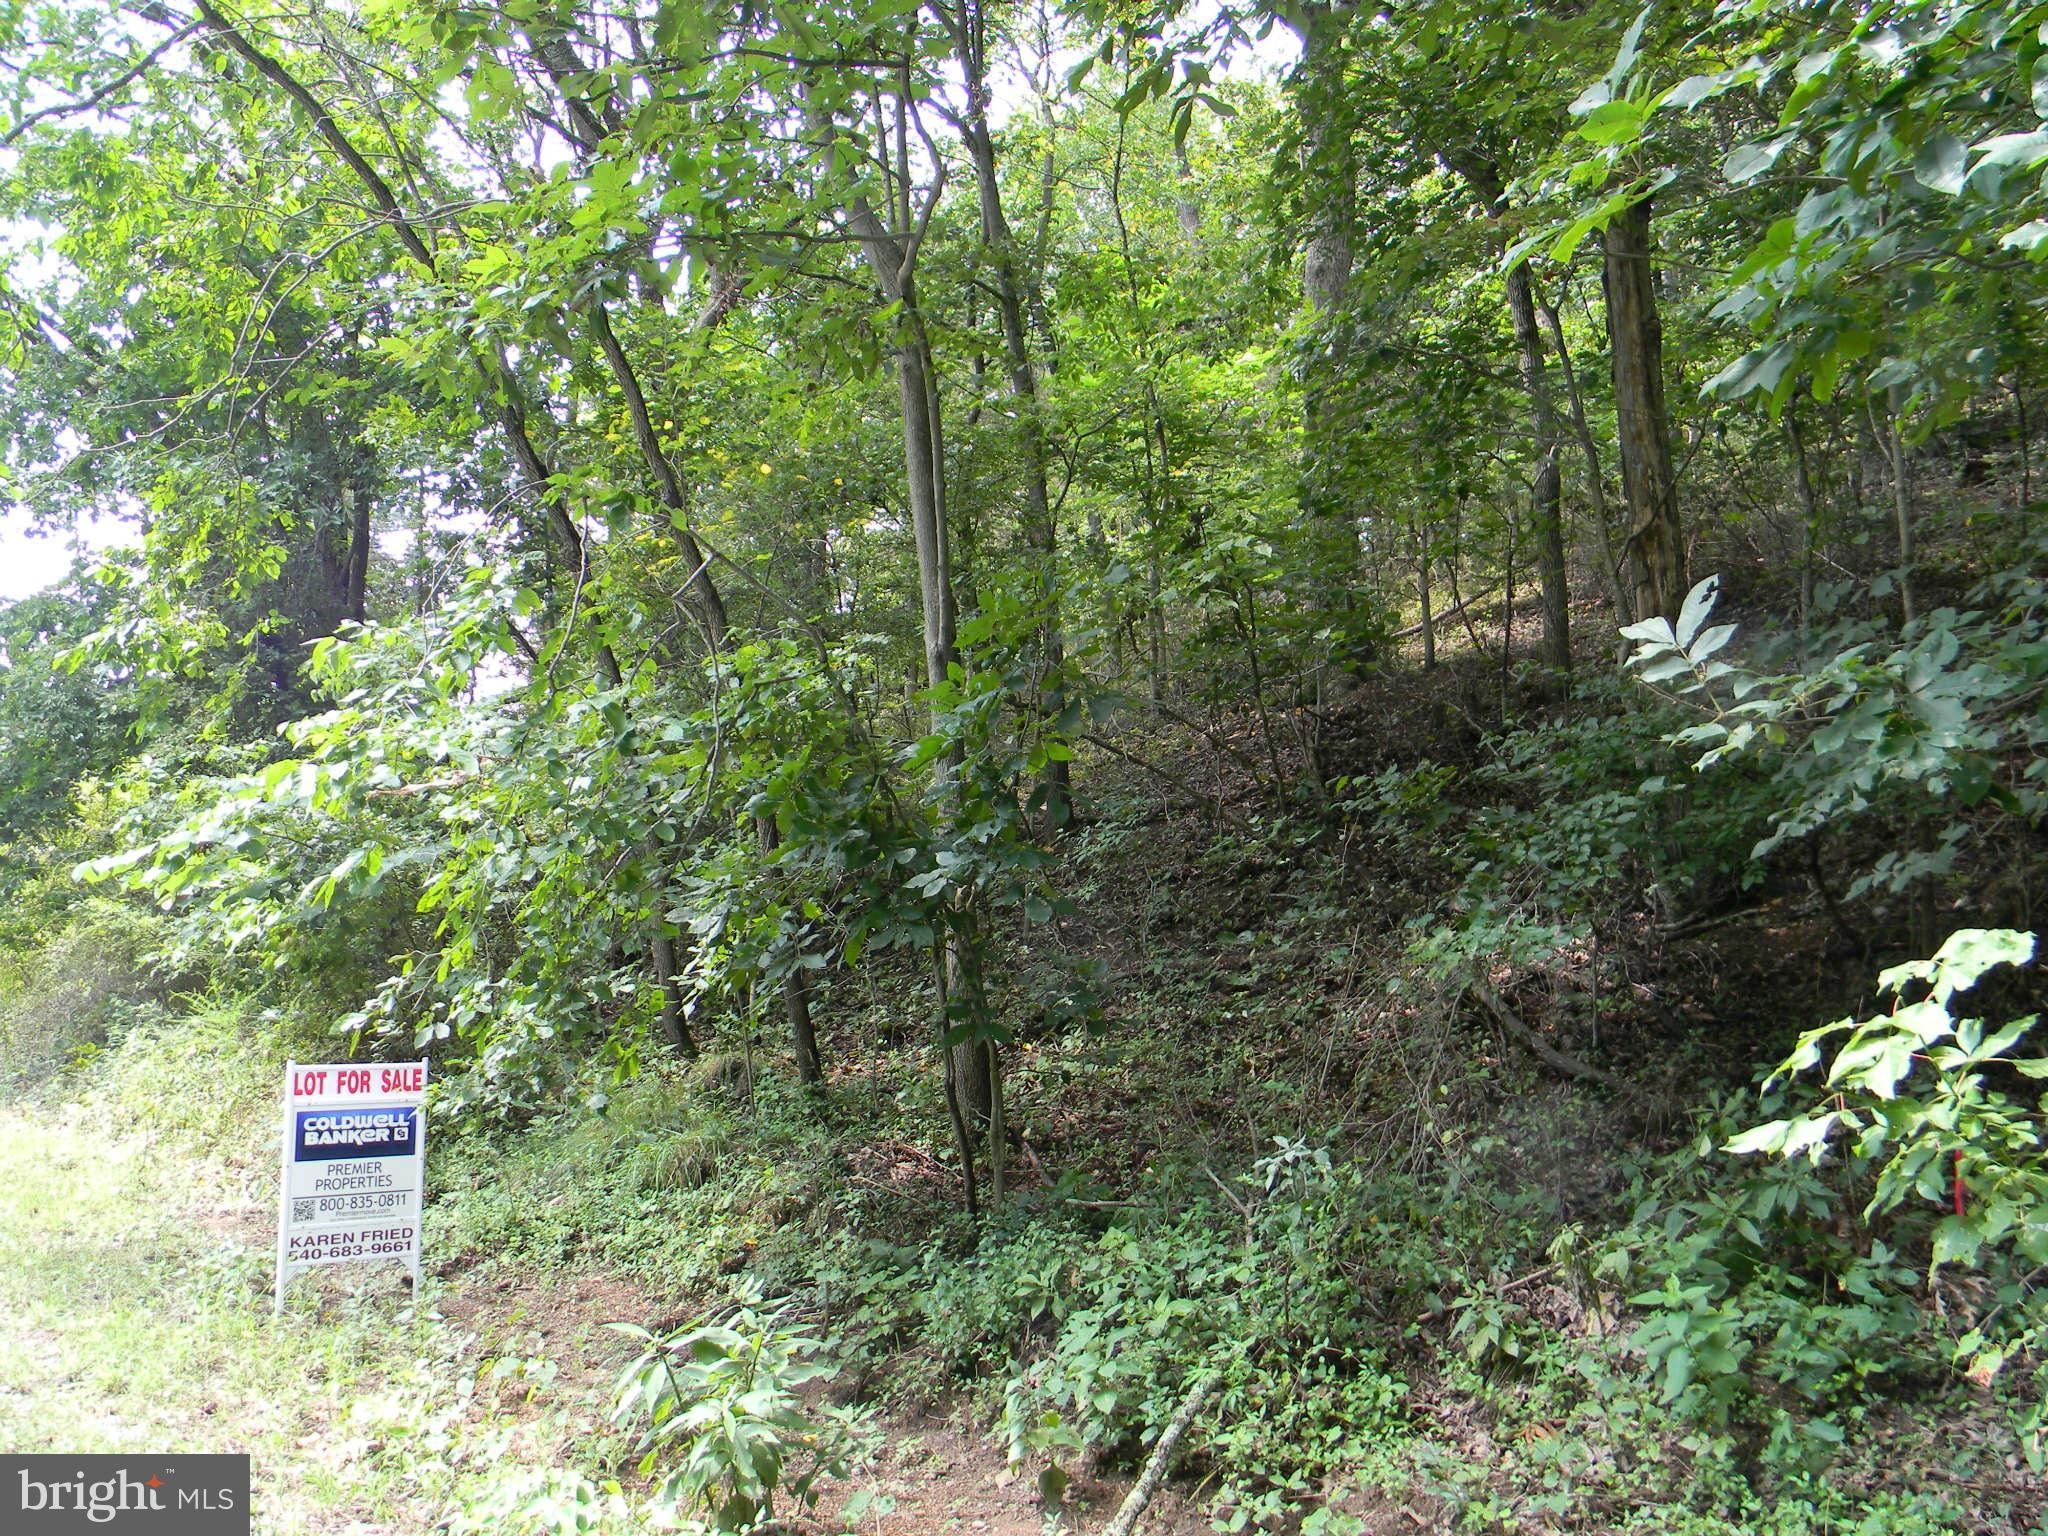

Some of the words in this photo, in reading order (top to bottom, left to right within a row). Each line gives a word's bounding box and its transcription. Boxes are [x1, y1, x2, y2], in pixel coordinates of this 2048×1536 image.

[293, 1071, 327, 1096] LOT
[337, 1070, 371, 1094] FOR
[381, 1068, 423, 1093] SALE
[303, 1113, 410, 1131] COLDWELL
[303, 1128, 390, 1146] BANKER
[327, 1161, 382, 1176] PREMIER
[315, 1174, 393, 1191] PROPERTIES
[319, 1193, 406, 1212] 800-835-0811
[290, 1232, 355, 1248] KAREN
[360, 1227, 414, 1242] FRIED
[288, 1240, 412, 1262] 540-683-9661
